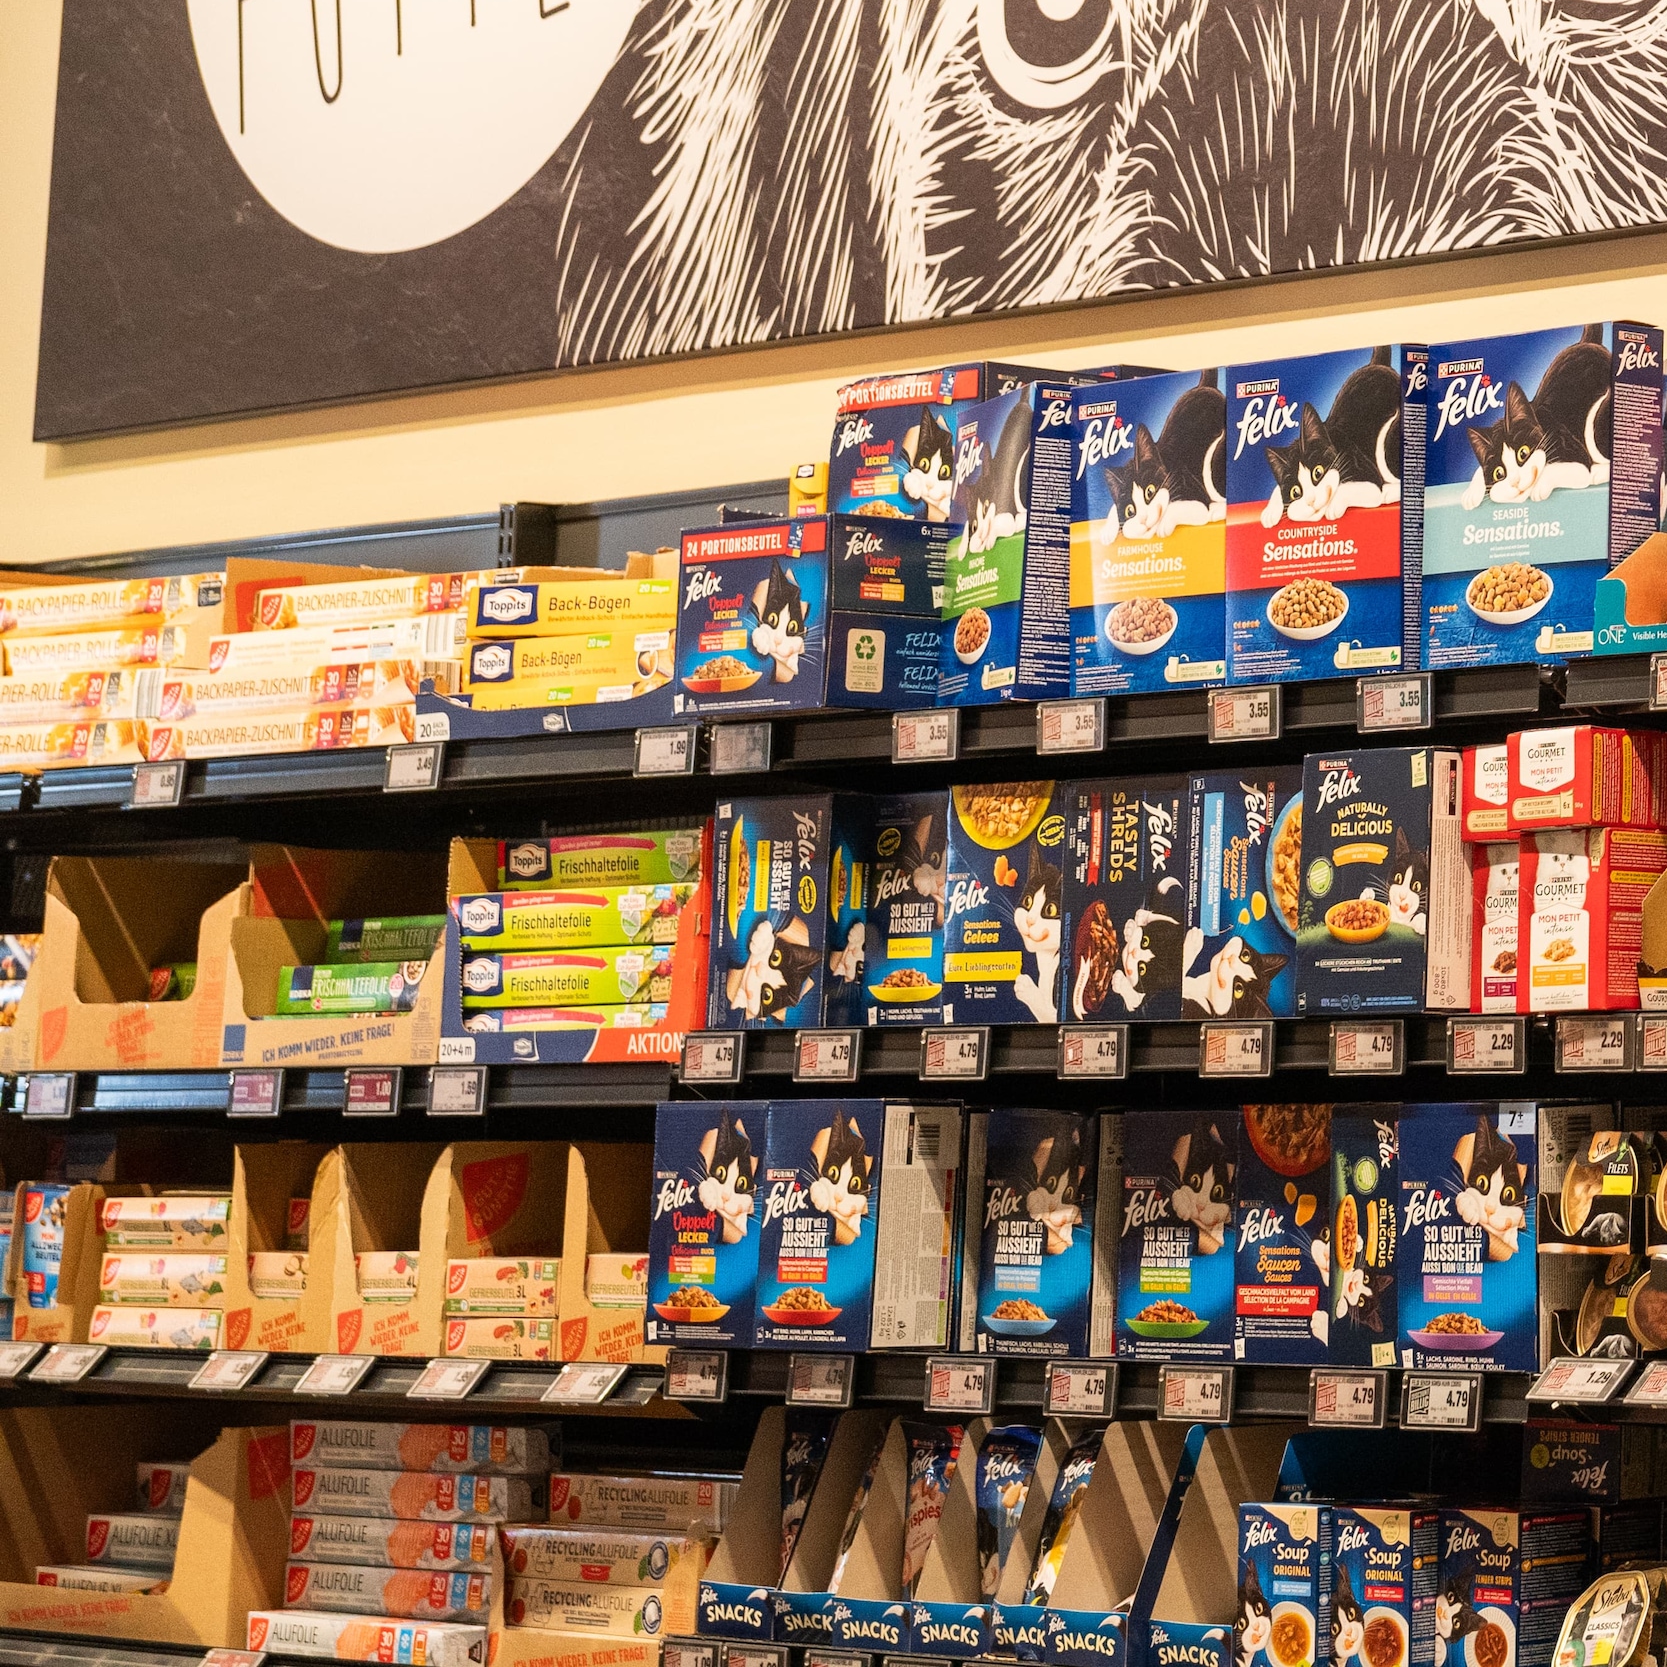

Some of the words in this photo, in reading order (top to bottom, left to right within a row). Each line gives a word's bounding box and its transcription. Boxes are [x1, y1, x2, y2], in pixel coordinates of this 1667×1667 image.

[1447, 360, 1482, 376] PURINA
[848, 381, 934, 405] PORTIONSBEUTEL
[1246, 381, 1279, 396] PURINA
[1086, 404, 1116, 416] PURINA
[1433, 375, 1502, 441] felix
[1233, 396, 1298, 460] felix
[1076, 417, 1132, 481] felix
[865, 454, 889, 467] LECKER
[1492, 506, 1530, 522] SEASIDE
[1277, 524, 1338, 541] COUNTRYSIDE
[686, 541, 698, 558] 24
[700, 533, 783, 555] PORTIONSBEUTEL
[1117, 542, 1164, 557] FARMHOUSE
[16, 589, 125, 617] BACKPAPIER-ROLLE
[297, 586, 424, 611] BACKPAPIER-ZUSCHNITTE
[488, 598, 527, 613] Toppits
[548, 595, 631, 612] Back-Bögen
[1633, 631, 1654, 641] Visible
[478, 656, 506, 668] Toppits
[521, 651, 582, 668] Back-Bögen
[195, 675, 321, 701] BACKPAPIER-ZUSCHNITTE
[1249, 702, 1269, 719] 3.55
[1075, 714, 1094, 730] 3.55
[929, 725, 947, 741] 3.55
[669, 740, 686, 755] 1.99
[416, 756, 433, 772] 3.49
[1336, 803, 1389, 820] NATURALLY
[1109, 791, 1124, 883] SHREDS
[1122, 800, 1139, 873] TASTY
[1331, 820, 1393, 838] DELICIOUS
[559, 857, 640, 874] Frischhaltefolie
[510, 914, 592, 930] Frischhaltefolie
[889, 917, 934, 933] AUSSIEHT
[1538, 914, 1557, 925] MON
[1559, 913, 1581, 924] PETIT
[963, 930, 999, 944] Gelees
[510, 976, 589, 992] Frischhaltefolie
[262, 1048, 277, 1062] ICH
[278, 1044, 301, 1059] KOMM
[339, 1033, 364, 1049] KEINE
[366, 1025, 394, 1043] FRAGE!
[627, 1033, 683, 1053] AKTION
[1491, 1033, 1513, 1051] 2.29
[831, 1045, 849, 1062] 4.79
[1607, 1162, 1628, 1174] FILETS
[1121, 1190, 1169, 1237] felix
[783, 1218, 794, 1231] SO
[795, 1218, 813, 1230] GUT
[1378, 1198, 1387, 1267] DELICIOUS
[678, 1232, 708, 1243] LECKER
[781, 1232, 826, 1248] AUSSIEHT
[1143, 1227, 1155, 1240] SO
[1157, 1227, 1174, 1240] GUT
[1423, 1242, 1483, 1261] AUSSIEHT
[1200, 1383, 1220, 1399] 4.79
[1446, 1390, 1468, 1408] 4.79
[319, 1476, 370, 1494] ALUFOLIE
[316, 1524, 367, 1542] ALUFOLIE
[1274, 1565, 1311, 1577] ORIGINAL
[1365, 1570, 1403, 1581] ORIGINAL
[312, 1573, 363, 1591] ALUFOLIE
[706, 1606, 762, 1627] SNACKS
[841, 1621, 899, 1644] SNACKS
[921, 1623, 979, 1646] SNACKS
[1055, 1634, 1116, 1656] SNACKS
